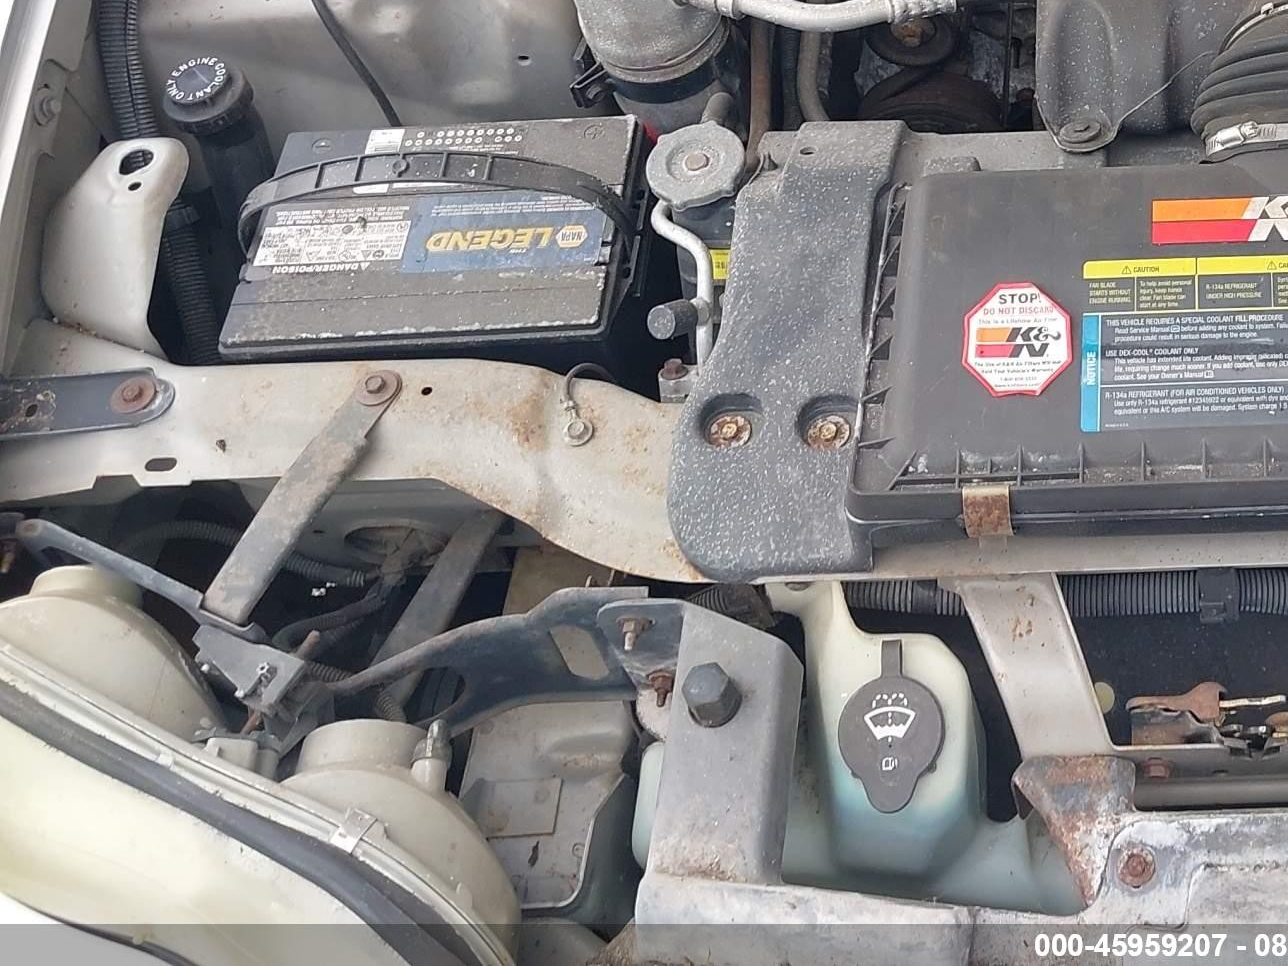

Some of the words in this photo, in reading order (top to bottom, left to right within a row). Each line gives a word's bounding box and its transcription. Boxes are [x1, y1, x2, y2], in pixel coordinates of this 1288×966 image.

[171, 56, 218, 77] ENGINE
[166, 79, 184, 100] ONLY
[186, 63, 226, 100] COOLANT
[426, 227, 552, 251] LEGEND
[559, 230, 585, 243] NAPA
[272, 264, 360, 275] DANGER/POISON
[999, 293, 1042, 304] STOP!
[983, 308, 995, 316] DO
[1019, 306, 1054, 314] DISCARD
[1006, 326, 1061, 358] K&N
[1086, 351, 1096, 385] NOTICE
[1196, 388, 1236, 396] CONDITIONED
